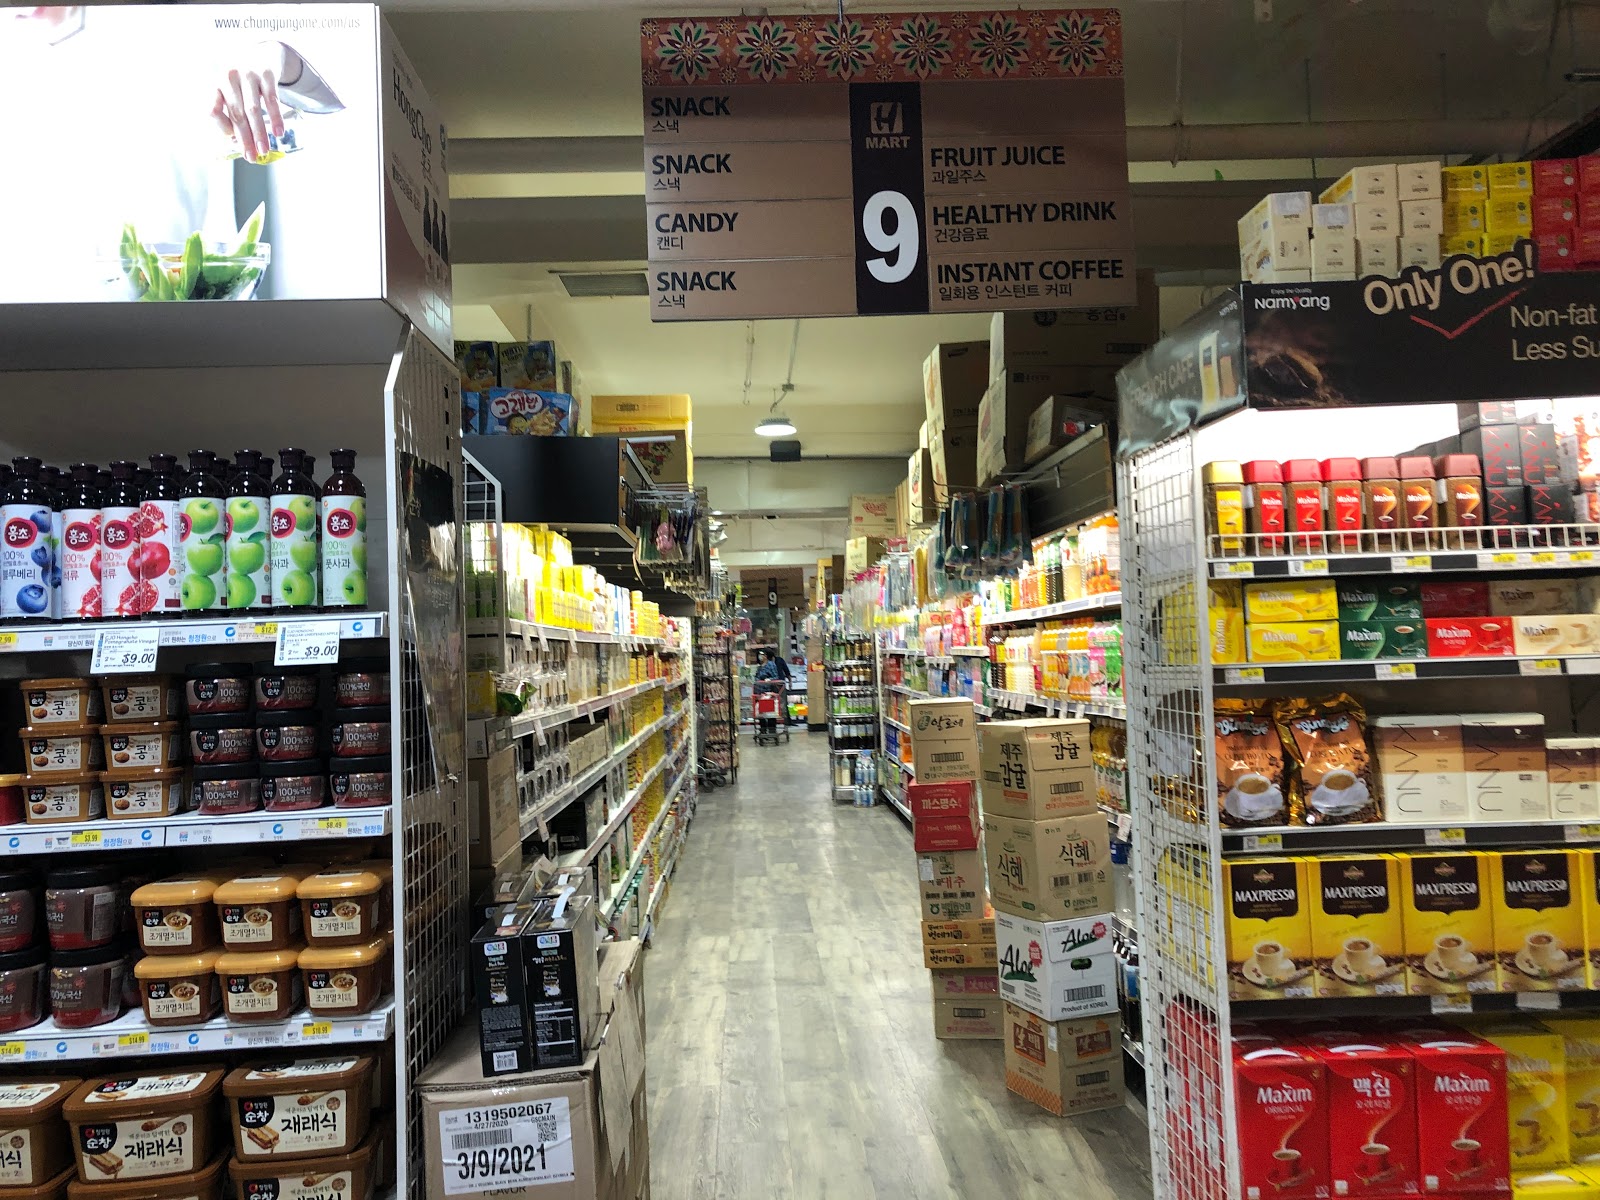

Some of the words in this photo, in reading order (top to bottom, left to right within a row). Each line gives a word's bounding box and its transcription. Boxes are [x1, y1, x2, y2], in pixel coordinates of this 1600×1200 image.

[214, 15, 361, 32] www.chungjungone.com/us
[651, 96, 731, 117] SNACK
[652, 119, 680, 133] 스낵
[865, 135, 911, 150] MART
[652, 153, 732, 174] SNACK
[930, 147, 998, 168] FRUIT
[1001, 145, 1066, 166] JUICE
[653, 176, 681, 191] 스낵
[931, 169, 988, 185] 과일주스
[655, 212, 739, 233] CANDY
[933, 203, 1038, 226] HEALTHY
[1043, 201, 1117, 222] DRINK
[656, 236, 684, 251] 캔디
[861, 189, 920, 284] 9
[934, 228, 990, 244] 건강음료
[656, 270, 737, 292] SNACK
[937, 261, 1034, 284] INSTANT
[1039, 259, 1124, 281] COFFEE
[1363, 271, 1443, 316] Only
[1450, 245, 1535, 295] One!
[938, 285, 980, 301] 일회용
[984, 283, 1041, 299] 인스턴트
[1045, 282, 1073, 297] 커피
[657, 294, 686, 309] 스낵
[1254, 295, 1331, 312] Namyang
[1511, 303, 1598, 328] Non-fat
[1512, 338, 1567, 361] Less
[768, 591, 778, 605] 9
[1347, 628, 1383, 642] Maxim
[1436, 626, 1472, 638] Maxim
[122, 653, 155, 665] $9.00
[305, 645, 338, 657] $9.00
[1050, 731, 1074, 742] 제주
[1001, 742, 1023, 761] 제주
[1051, 743, 1081, 760] 감귤
[999, 761, 1027, 789] 감귤
[1059, 840, 1090, 867] 식혜
[998, 853, 1024, 887] 식혜
[1234, 888, 1296, 903] MAXPRESSO
[1324, 885, 1386, 899] MAXPRESSO
[1415, 882, 1478, 896] MAXPRESSO
[1506, 879, 1568, 893] MAXPRESSO
[1061, 928, 1096, 954] Aloe
[999, 944, 1035, 978] Aloe
[1353, 1070, 1391, 1098] 맥심
[1434, 1071, 1490, 1093] Maxim
[1257, 1081, 1312, 1105] Maxim
[244, 1111, 270, 1124] 순창
[464, 1102, 553, 1124] 1319502067
[281, 1111, 338, 1135] 재래식
[474, 1119, 509, 1130] 4/27/2020
[86, 1137, 112, 1150] 순창
[124, 1136, 184, 1160] 재래식
[457, 1142, 547, 1180] 3/9/2021
